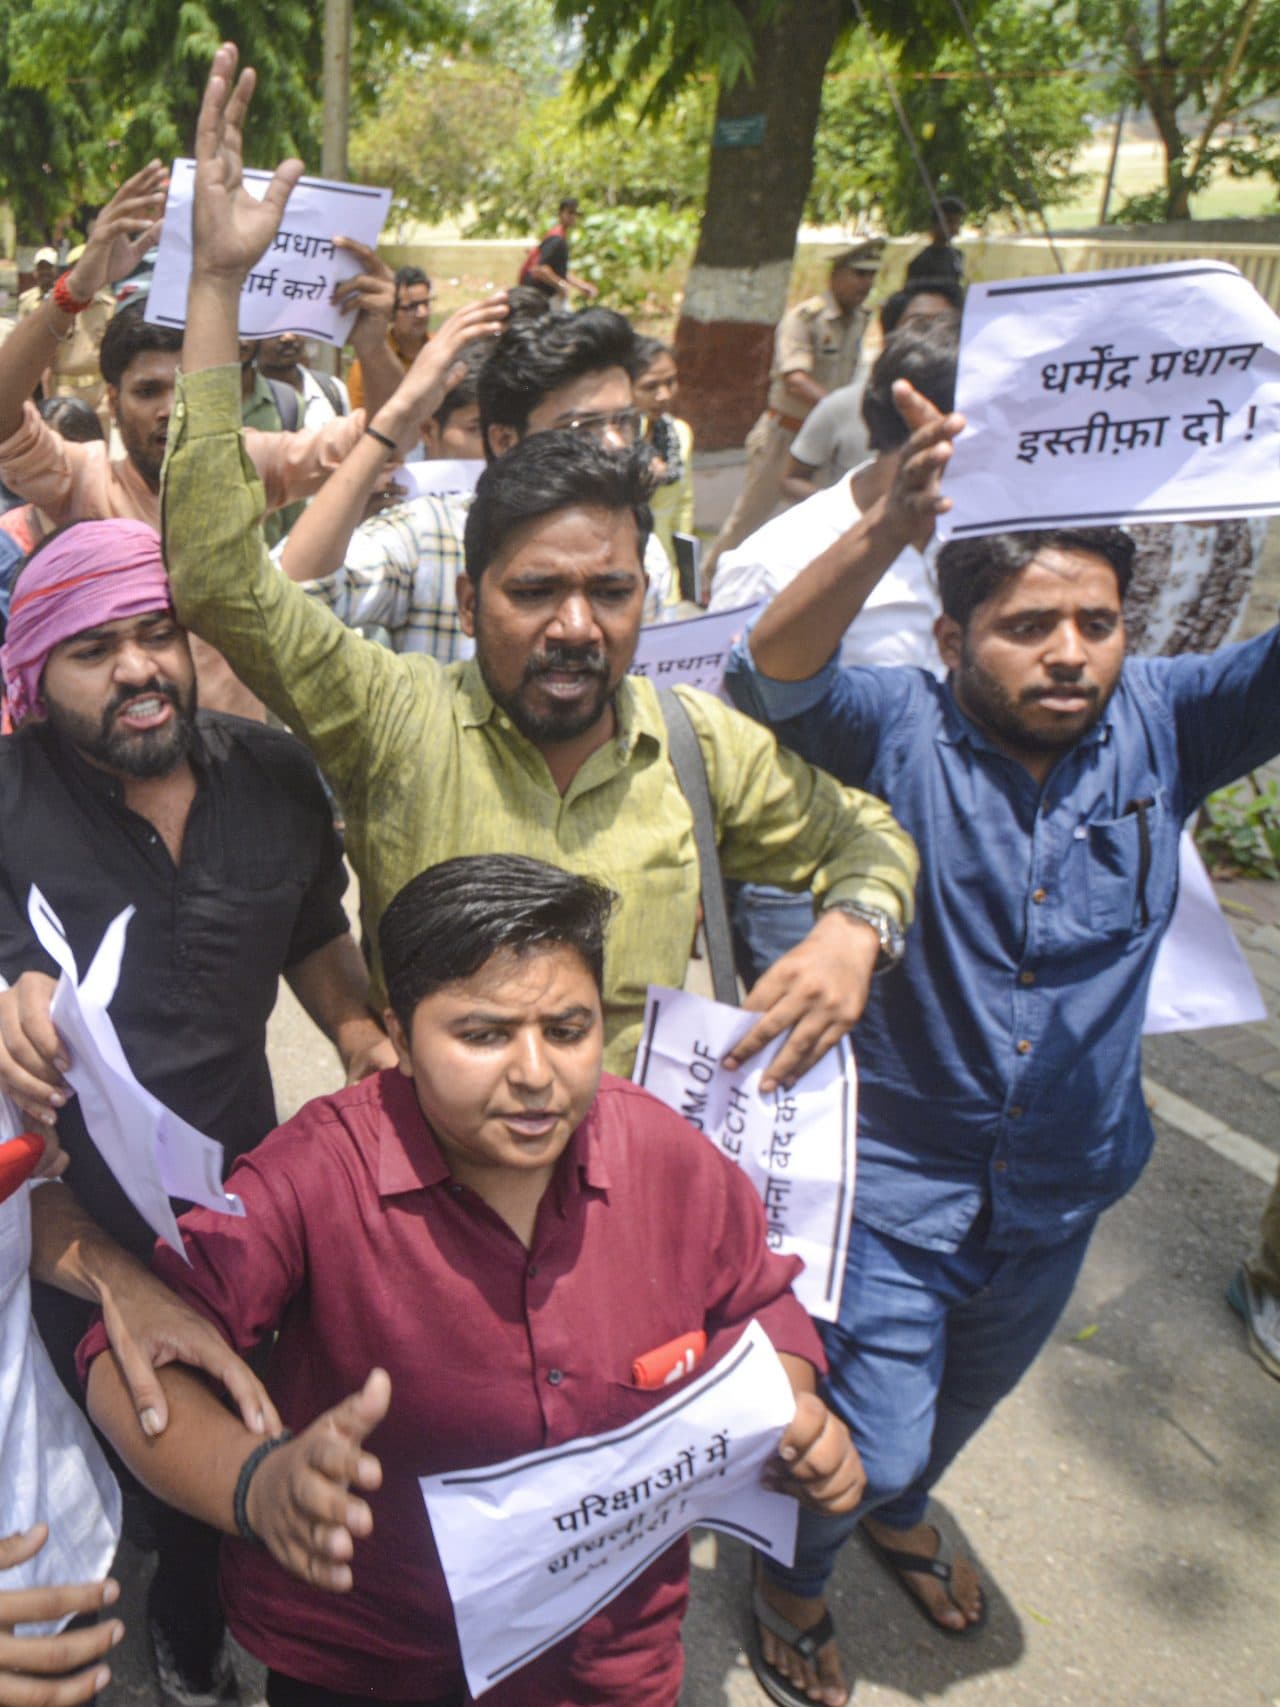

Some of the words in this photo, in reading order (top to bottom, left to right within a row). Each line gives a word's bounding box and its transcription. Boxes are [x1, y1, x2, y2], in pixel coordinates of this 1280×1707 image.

[272, 231, 336, 260] प्रधान
[282, 275, 328, 300] करो
[1041, 344, 1139, 393] धर्मेंद्र
[1146, 342, 1264, 384] प्रधान
[1182, 399, 1231, 446] दो
[1244, 405, 1257, 441] !
[689, 1040, 717, 1084] OF
[722, 1085, 750, 1164] ECH
[553, 1445, 696, 1532] परिक्षाओं
[705, 1429, 729, 1463] में
